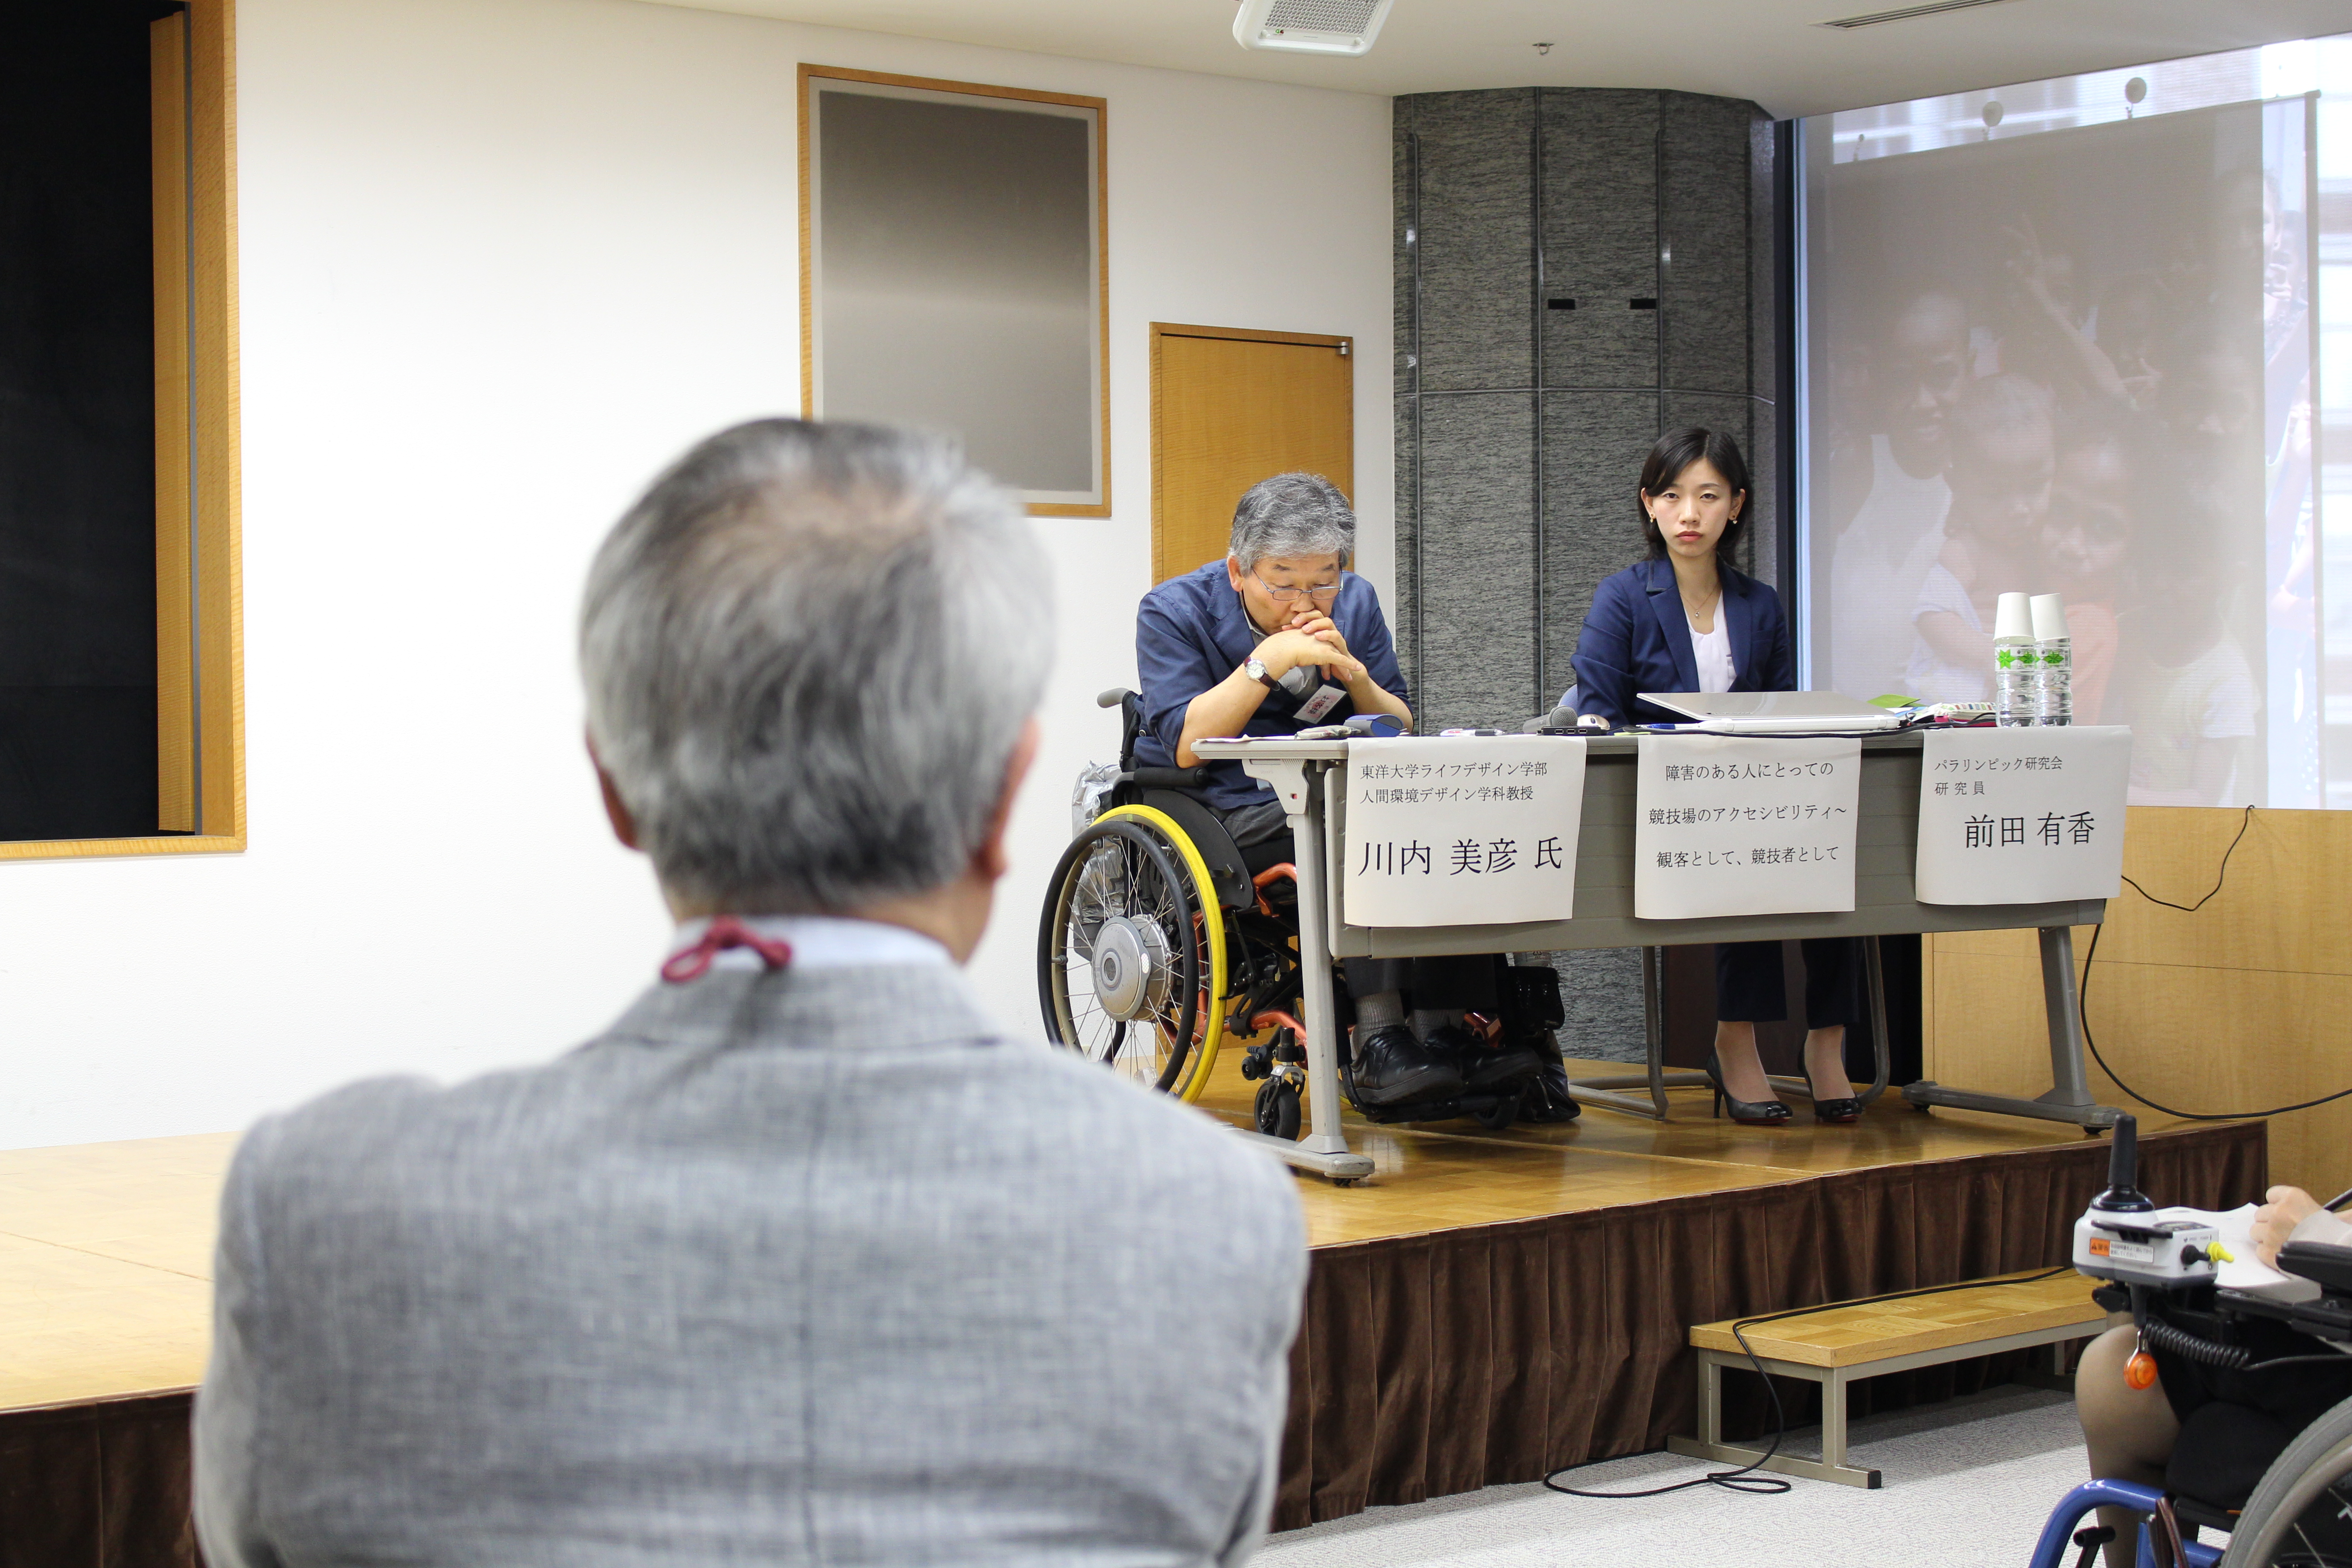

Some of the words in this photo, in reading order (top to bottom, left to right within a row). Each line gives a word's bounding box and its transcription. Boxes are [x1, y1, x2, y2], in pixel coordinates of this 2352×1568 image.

[1360, 761, 1548, 780] 東洋大学ライフデザイン学部
[1666, 762, 1833, 782] 障害のある人にとっての
[1935, 755, 2063, 773] パラリンピック研究会
[1360, 785, 1534, 804] 人間環境デザイン学科教授
[1964, 813, 2025, 848] 前田
[2037, 811, 2095, 846] 有香
[1358, 839, 1431, 877] 川内
[1534, 836, 1563, 869] 氏
[1656, 846, 1839, 869] 観客として、競技者として
